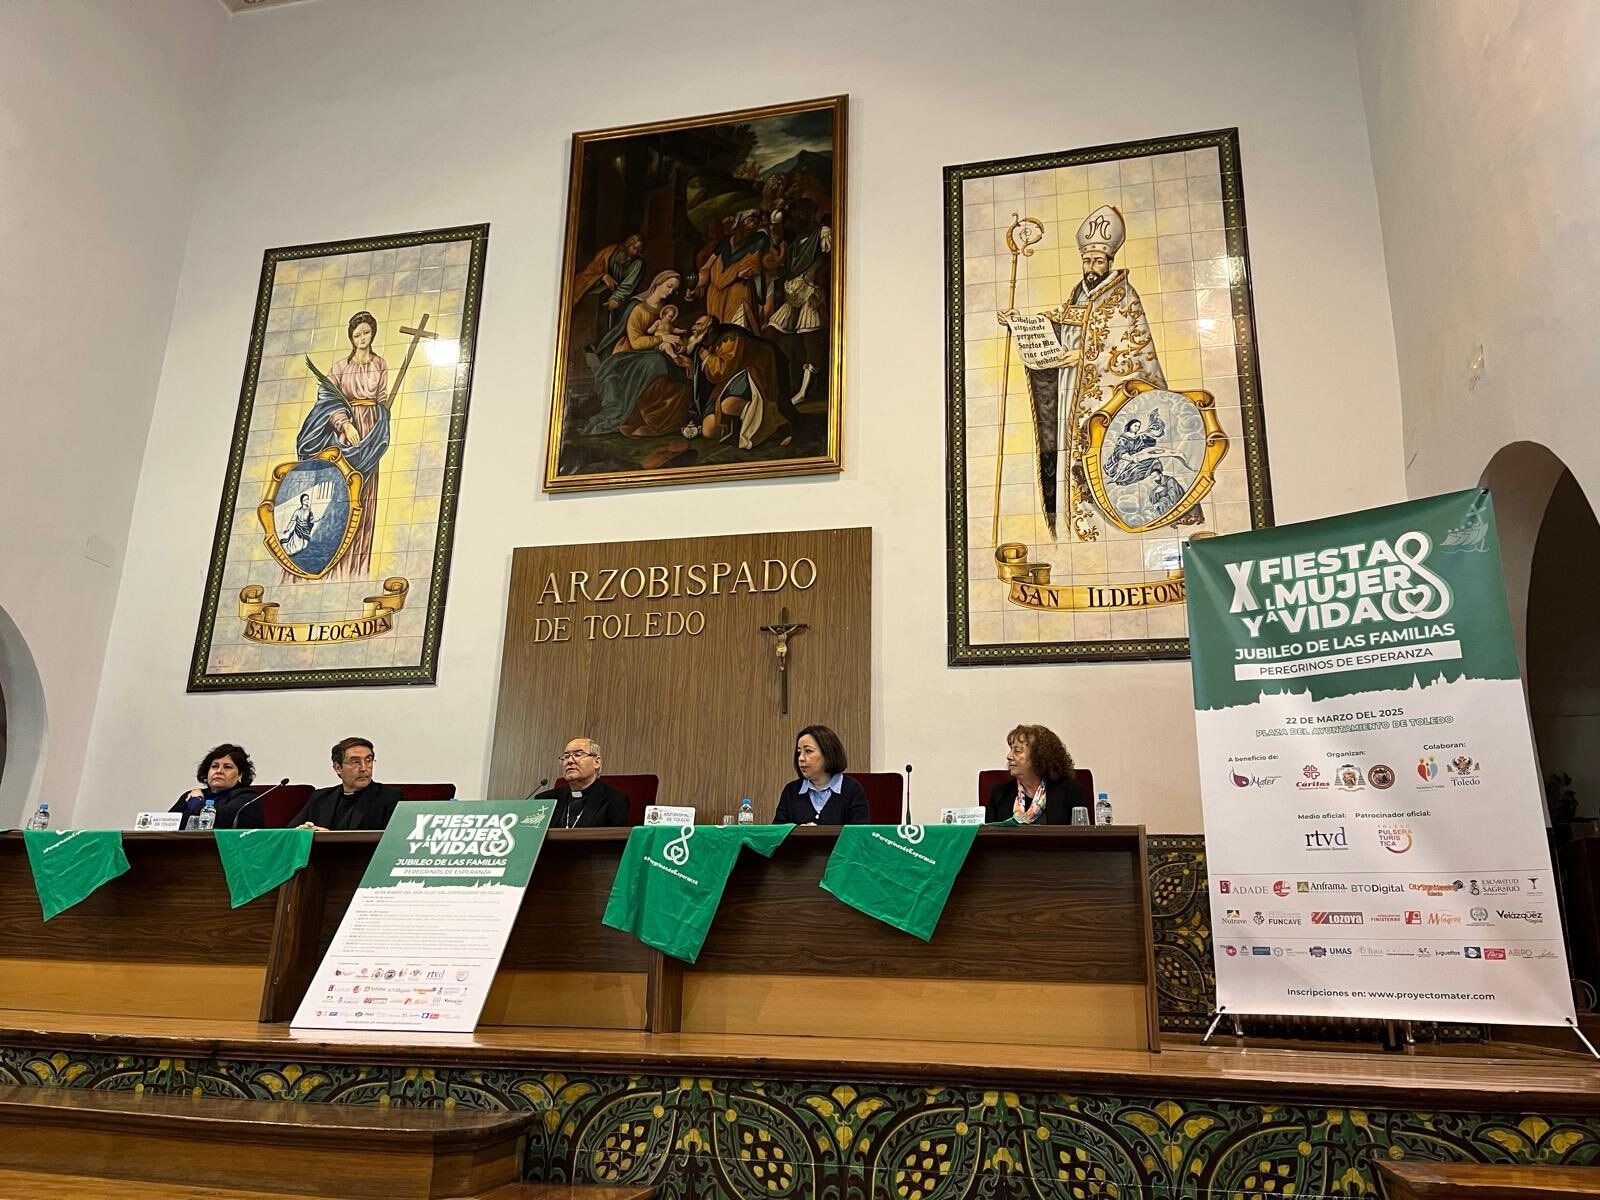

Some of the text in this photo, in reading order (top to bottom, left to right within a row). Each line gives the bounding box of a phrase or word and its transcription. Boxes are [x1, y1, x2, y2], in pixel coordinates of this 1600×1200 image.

[536, 557, 817, 605] ARZOBISPADO
[1224, 540, 1399, 613] X FIESTA
[1275, 565, 1412, 609] MUJER
[1016, 585, 1059, 607] SAN
[1243, 597, 1384, 637] Y VIDA
[247, 617, 390, 642] SANTA LEOCADIA
[533, 610, 705, 643] DE TOLEDO
[1235, 623, 1456, 661] JUBILEO DE LAS FAMILIAS
[1260, 647, 1433, 676] PEREGRINOS DE ESPERANZA
[1285, 708, 1404, 725] 22 DE MARZO DEL 2025
[1256, 715, 1455, 737] PLAZA DEL AYUNTAMIENTO DE TOLEDO
[1326, 750, 1366, 759] Organizan:
[1423, 742, 1466, 751] Colaboran:
[1296, 780, 1330, 788] Cáritas
[1451, 777, 1481, 787] Toledo
[1406, 810, 1431, 818] oficial:
[407, 814, 500, 840] X FIESTA
[431, 828, 502, 842] MUJER
[1305, 827, 1348, 847] rtvd
[409, 841, 479, 855] Y VIDA
[1232, 886, 1268, 894] ADADE
[1351, 884, 1404, 894] BTODigital
[1496, 910, 1543, 923] Velázquez
[1329, 947, 1352, 955] UMAS
[1287, 988, 1349, 997] Inscripciones
[1368, 991, 1495, 1000] www.proyectomater.com
